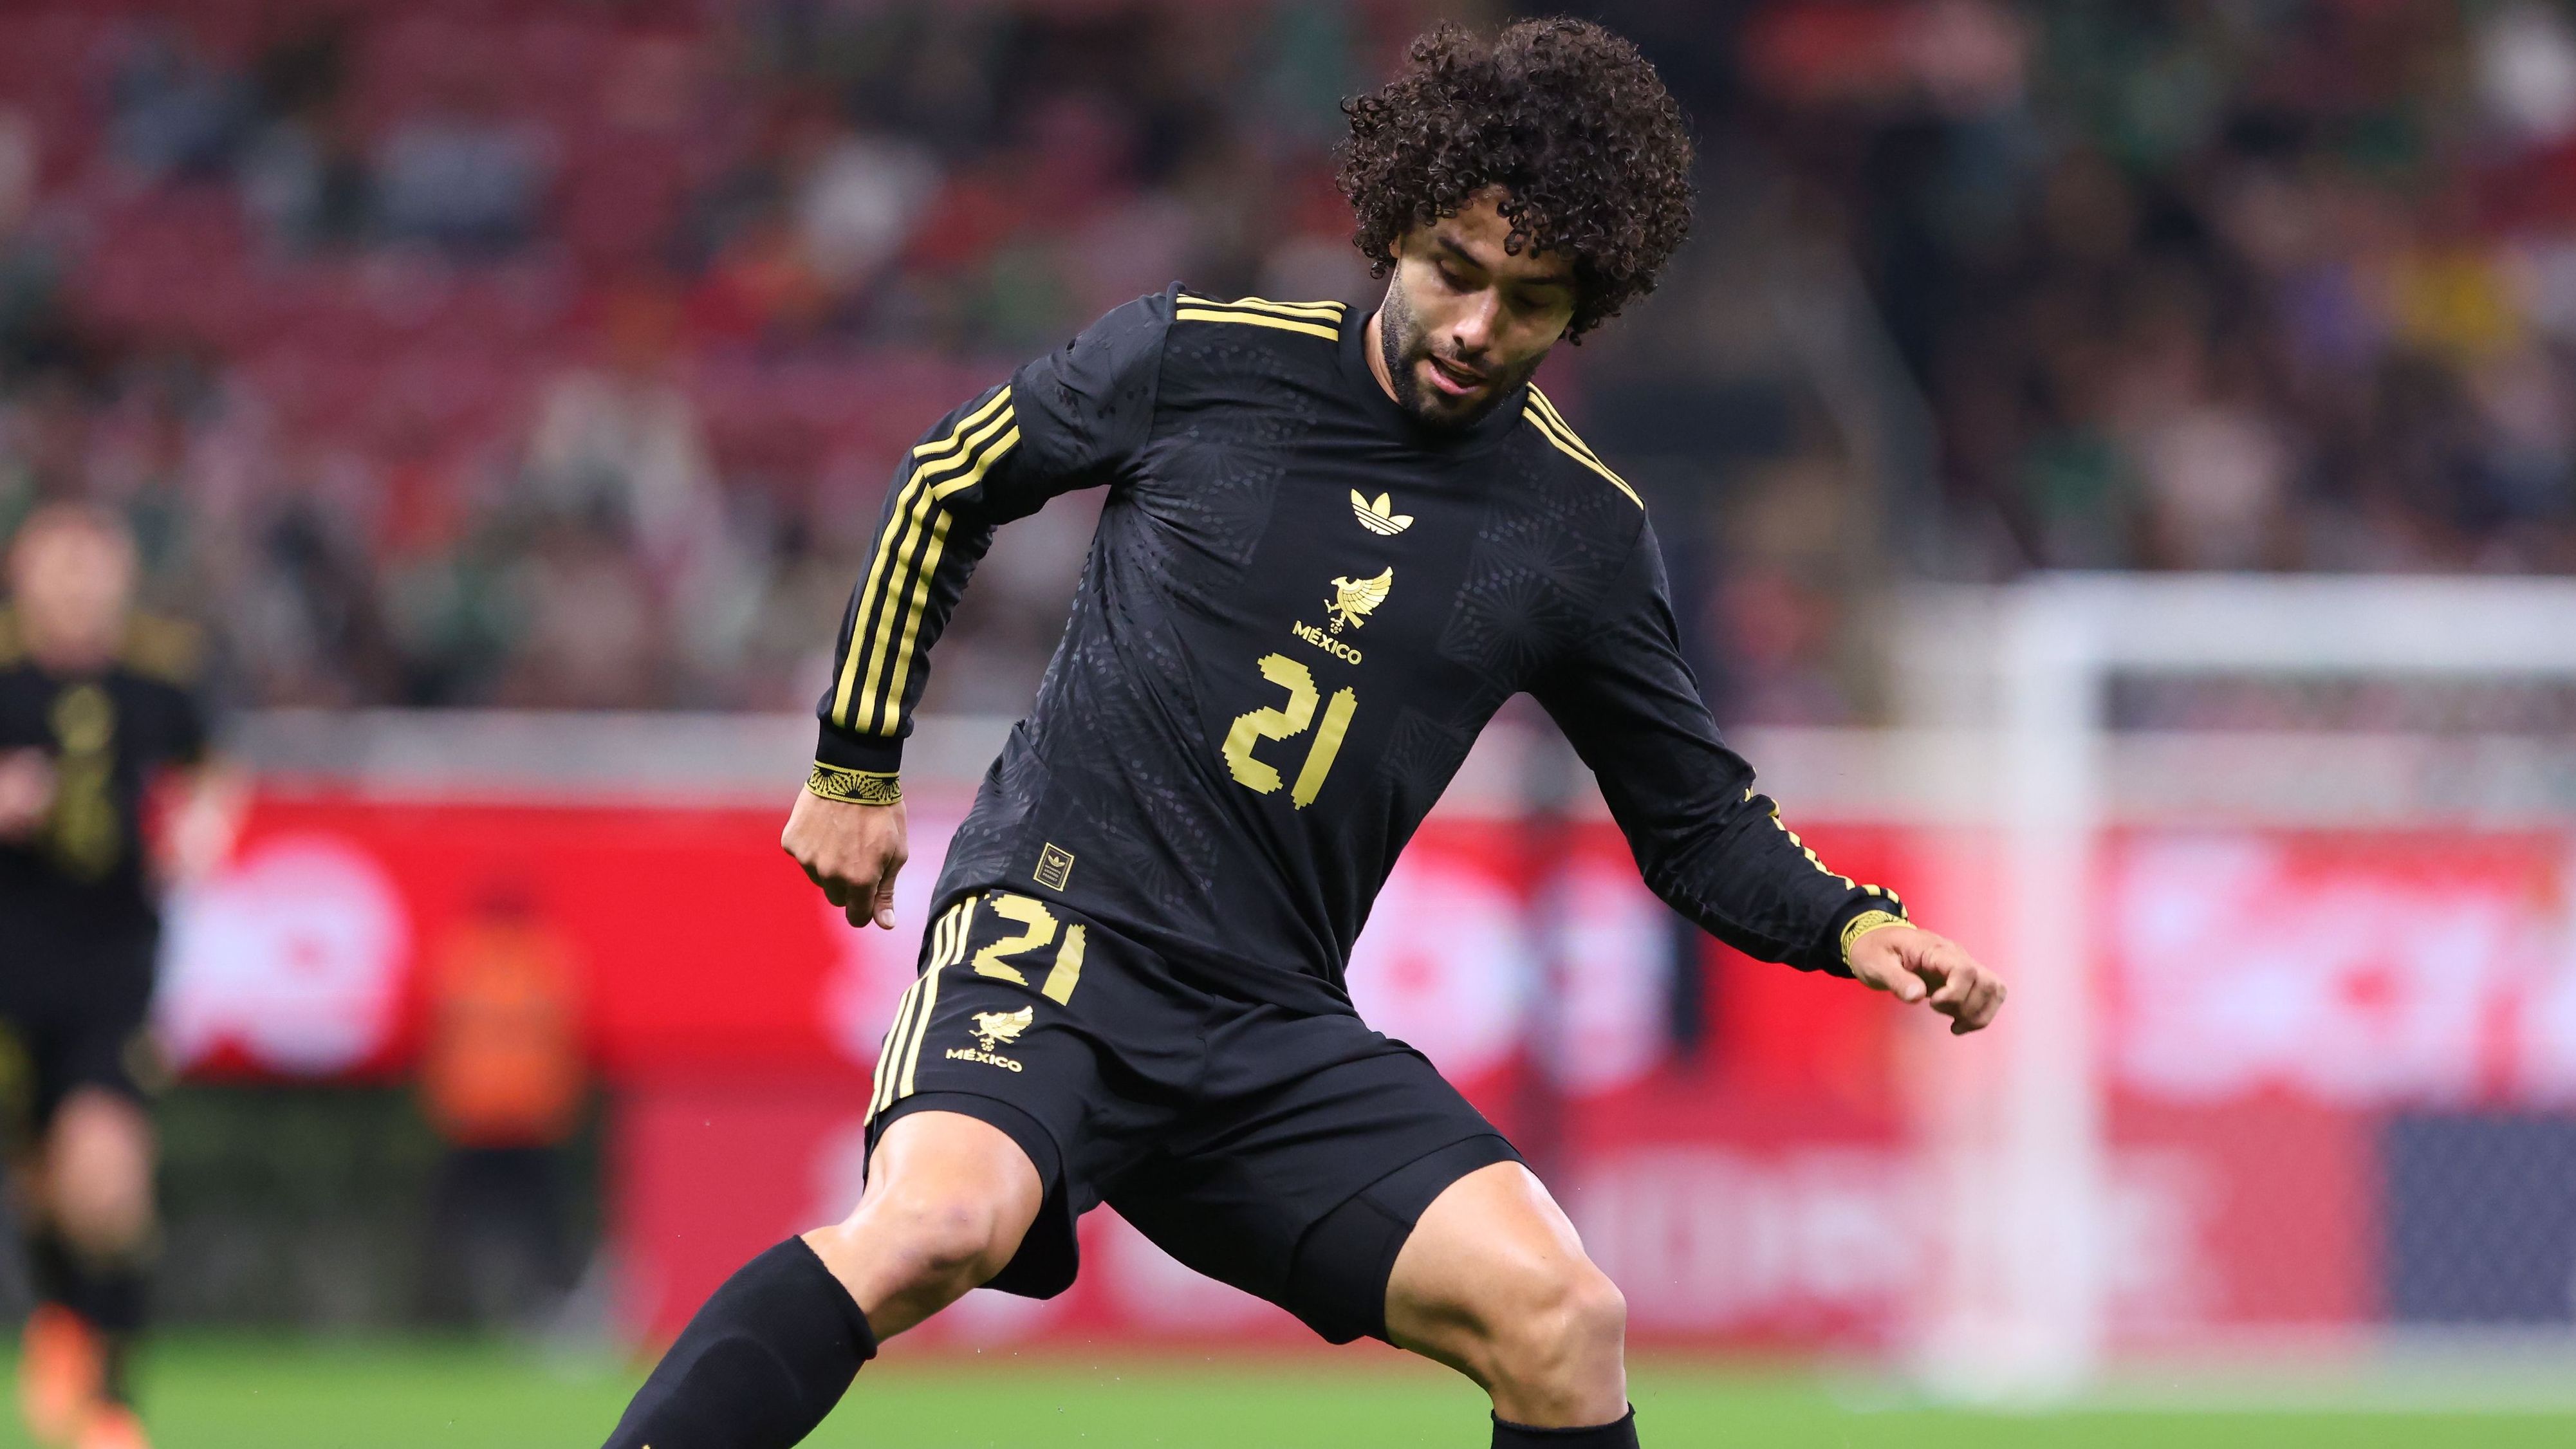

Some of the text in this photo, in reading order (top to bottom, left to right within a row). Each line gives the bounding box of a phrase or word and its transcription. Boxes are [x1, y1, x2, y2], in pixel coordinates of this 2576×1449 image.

[1292, 620, 1362, 665] MÉXICO
[1221, 652, 1358, 811] 21
[970, 893, 1087, 1007] 21
[945, 1048, 1023, 1073] MÉXICO
